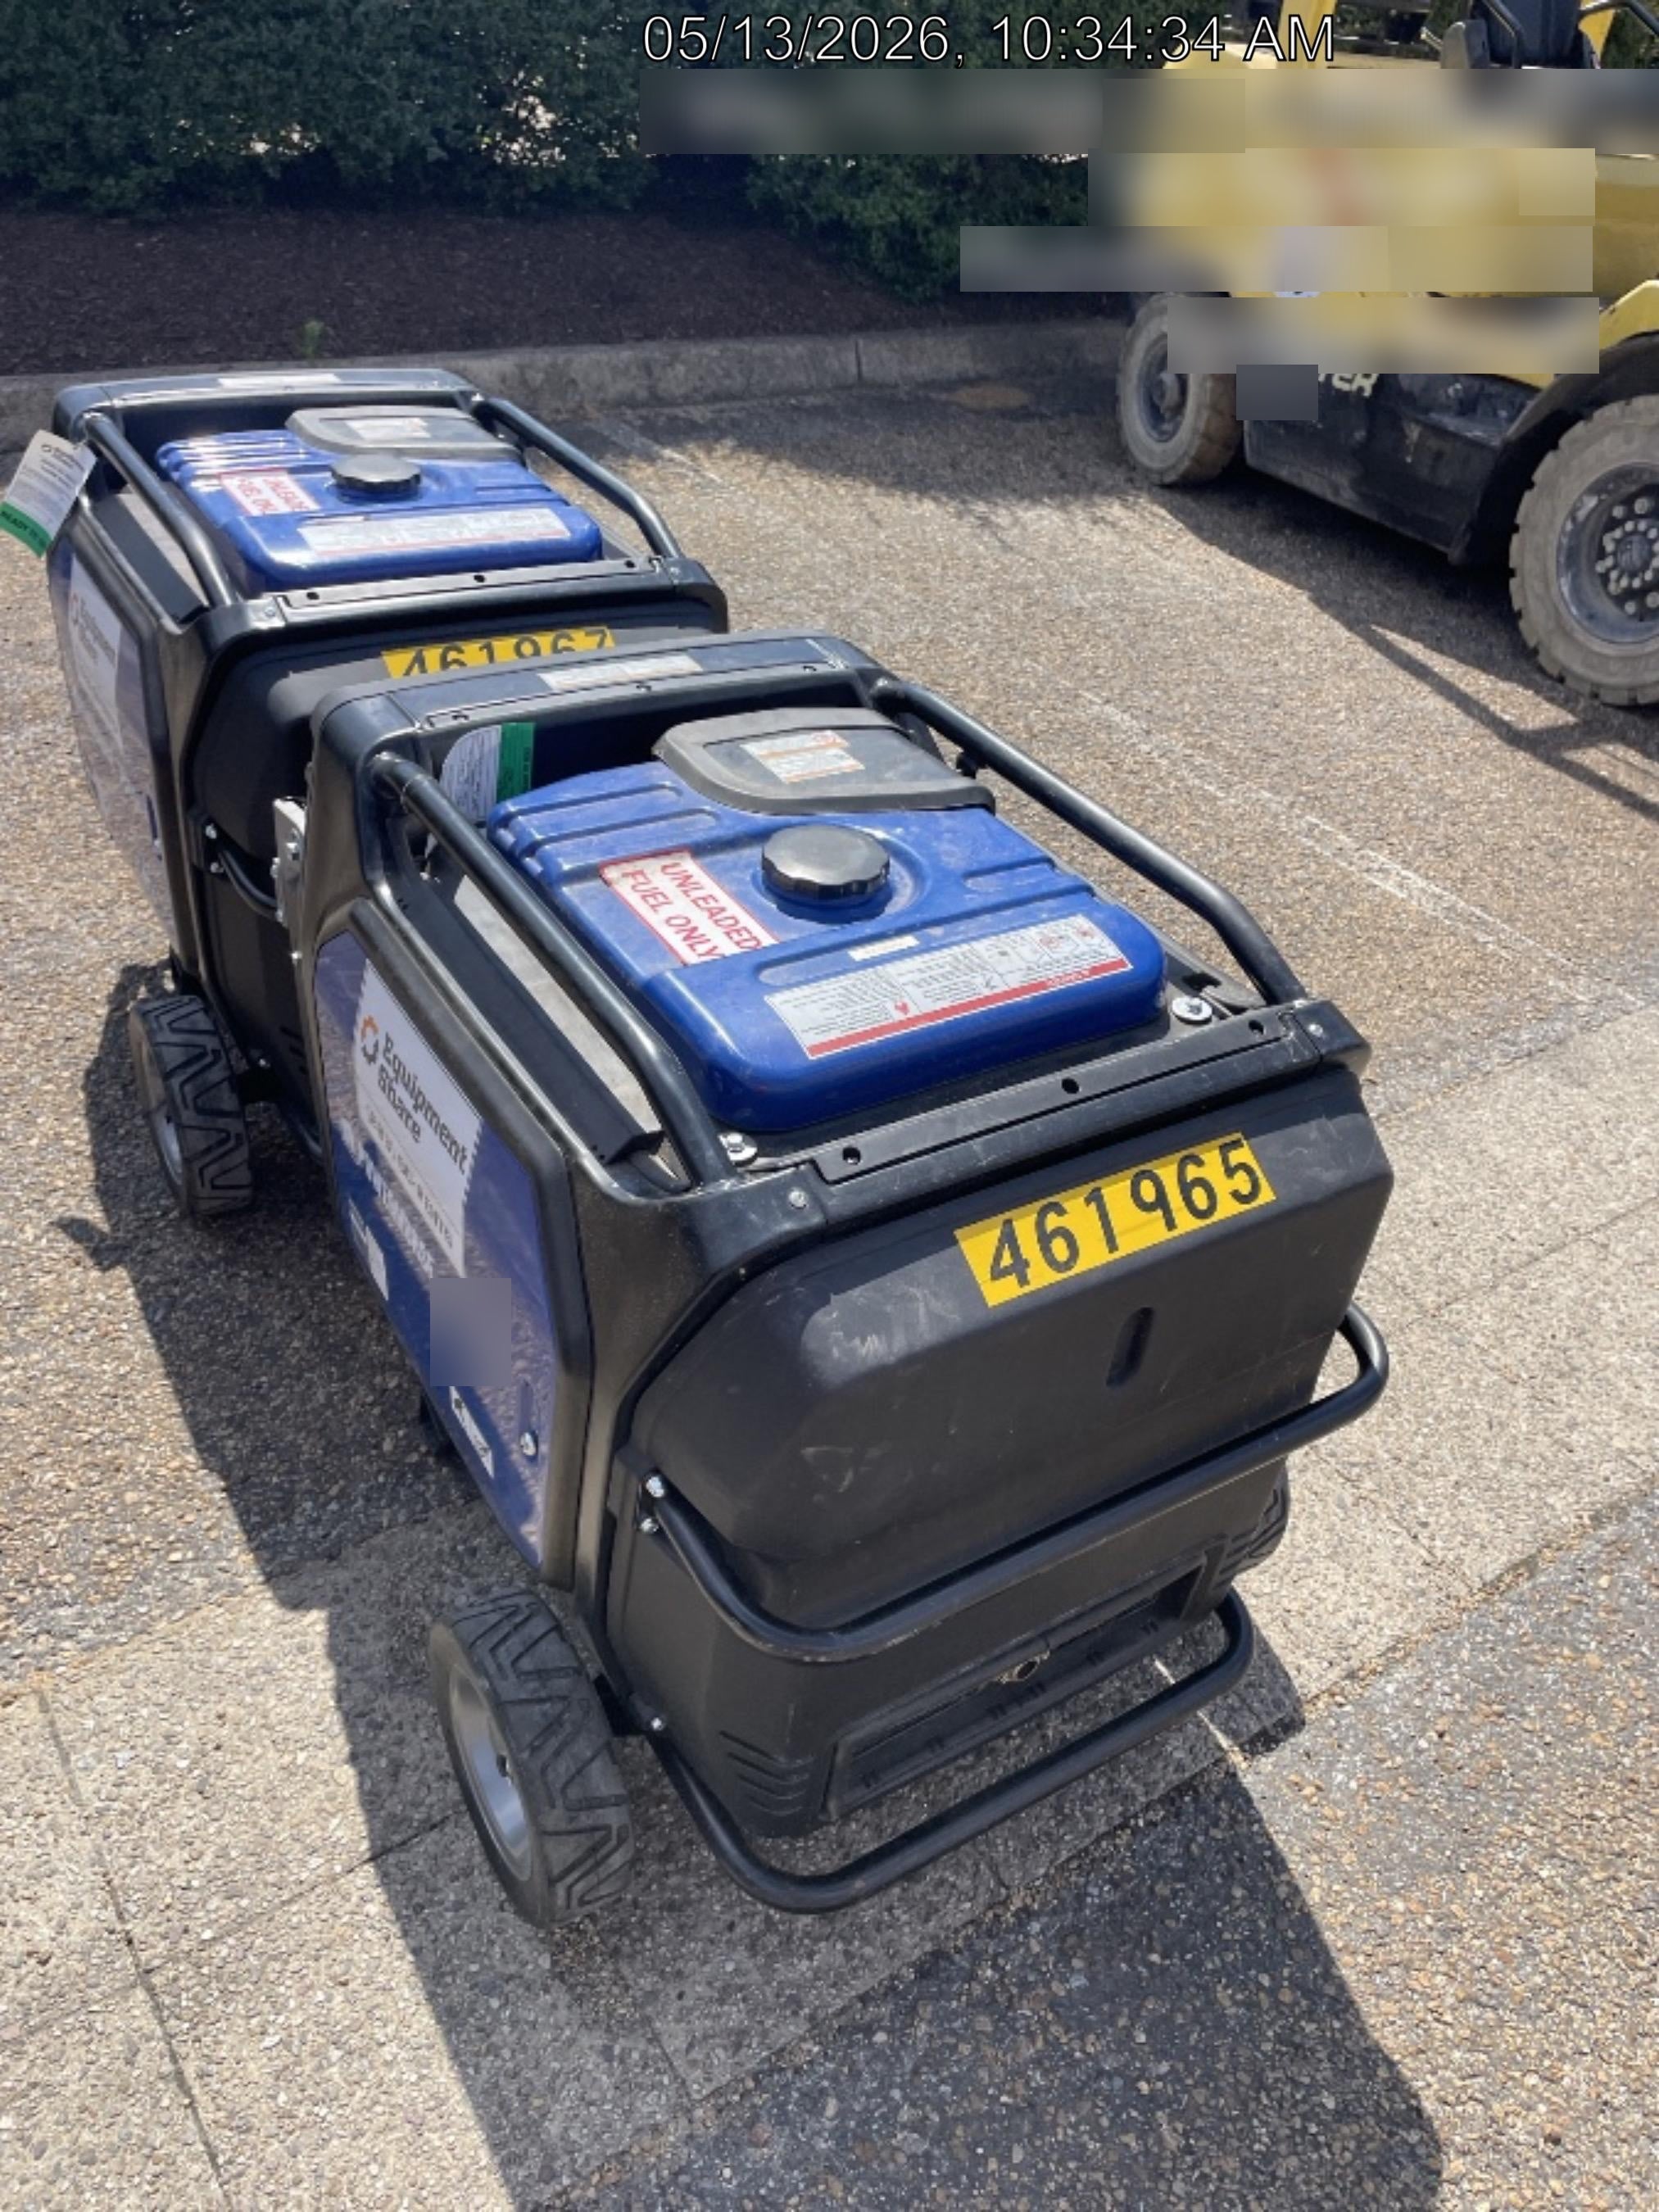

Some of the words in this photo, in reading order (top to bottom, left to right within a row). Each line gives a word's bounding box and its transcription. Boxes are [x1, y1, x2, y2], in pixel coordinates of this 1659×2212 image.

[621, 868, 673, 915] FUEL
[664, 913, 725, 959] ONLY
[660, 861, 762, 950] UNLEADED
[378, 1063, 421, 1144] Share
[383, 1031, 469, 1176] Equipment
[989, 1140, 1262, 1288] 461965
